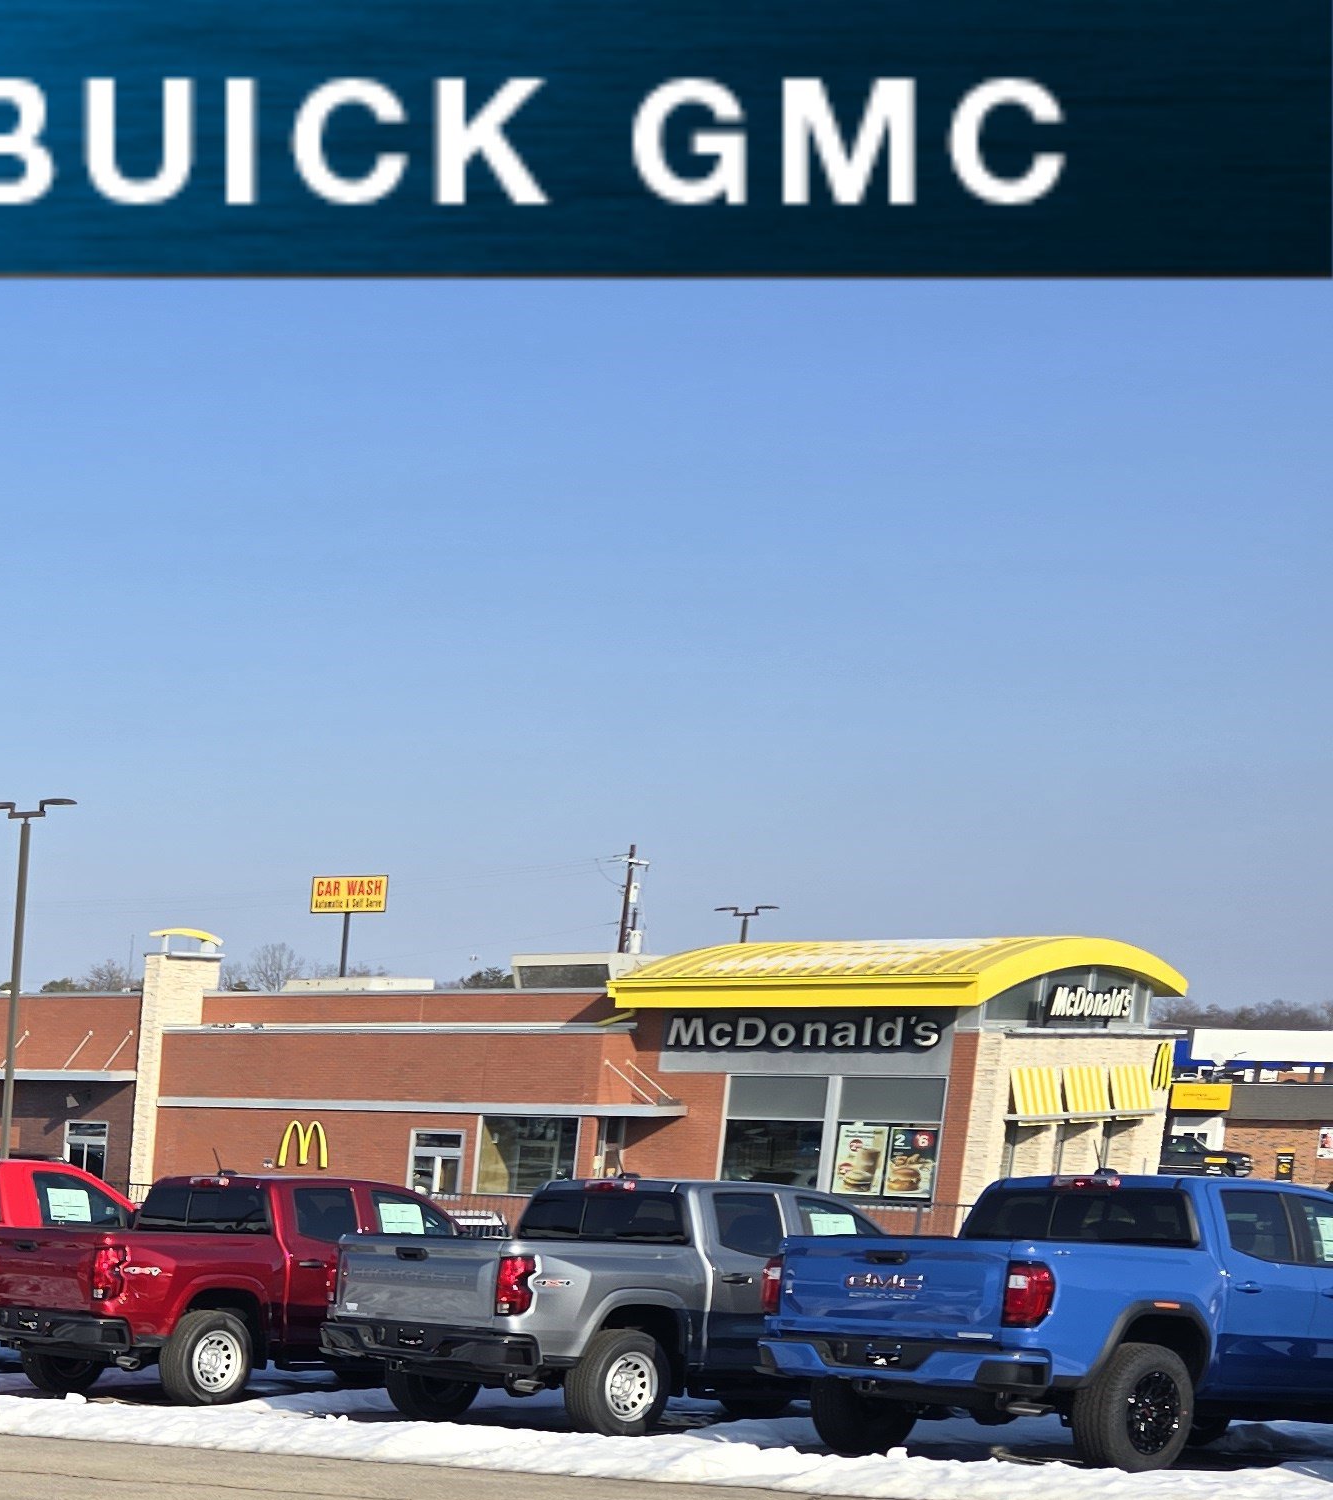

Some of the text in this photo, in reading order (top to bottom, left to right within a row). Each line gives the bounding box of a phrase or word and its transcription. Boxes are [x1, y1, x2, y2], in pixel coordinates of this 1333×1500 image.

[317, 880, 382, 896] CAR WASH
[1048, 985, 1133, 1018] McDonald's
[666, 1015, 940, 1048] McDonald's
[845, 1273, 924, 1290] GMC
